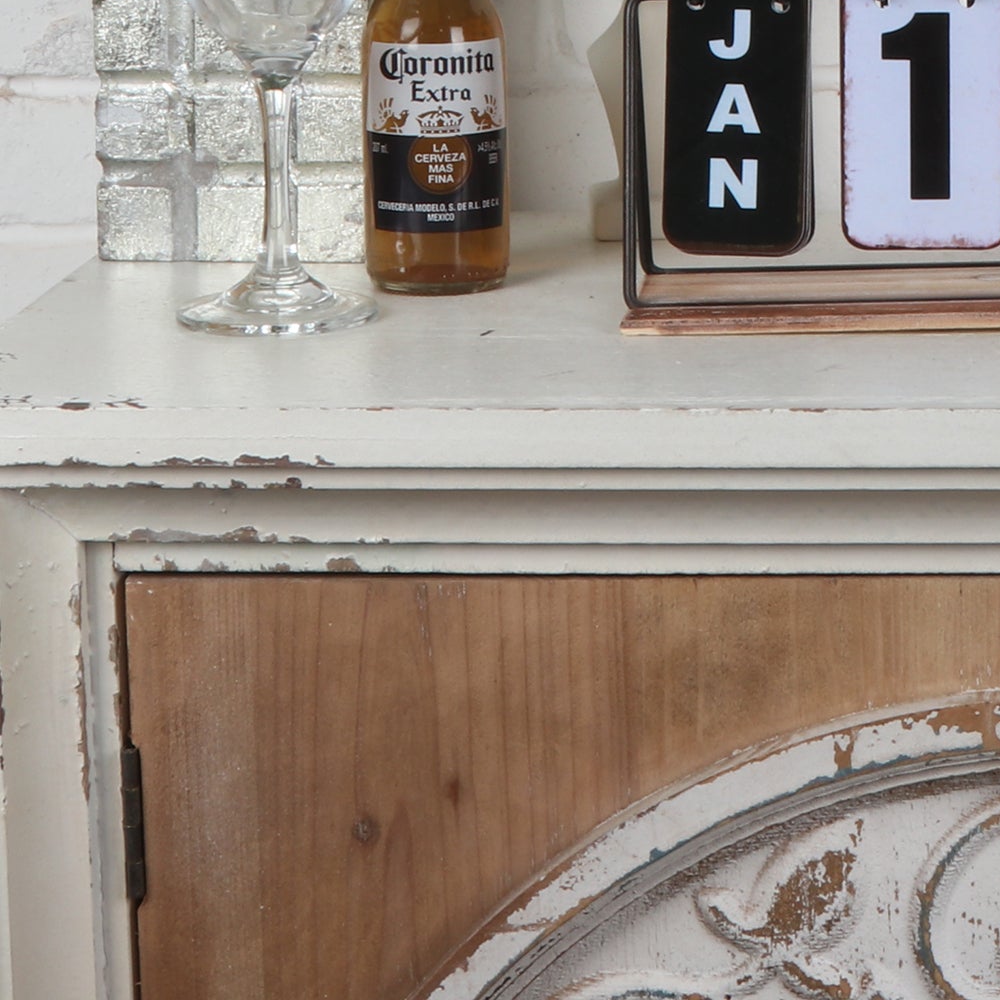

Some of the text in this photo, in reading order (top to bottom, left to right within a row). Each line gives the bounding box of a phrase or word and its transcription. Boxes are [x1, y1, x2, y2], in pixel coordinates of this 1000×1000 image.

[379, 47, 494, 84] Coronita
[410, 80, 472, 102] Extra
[706, 9, 761, 210] JAN
[432, 143, 449, 153] LA
[414, 152, 466, 164] CERVEZA
[428, 163, 454, 174] MAS
[428, 174, 454, 184] FINA
[427, 213, 455, 222] MEXICO
